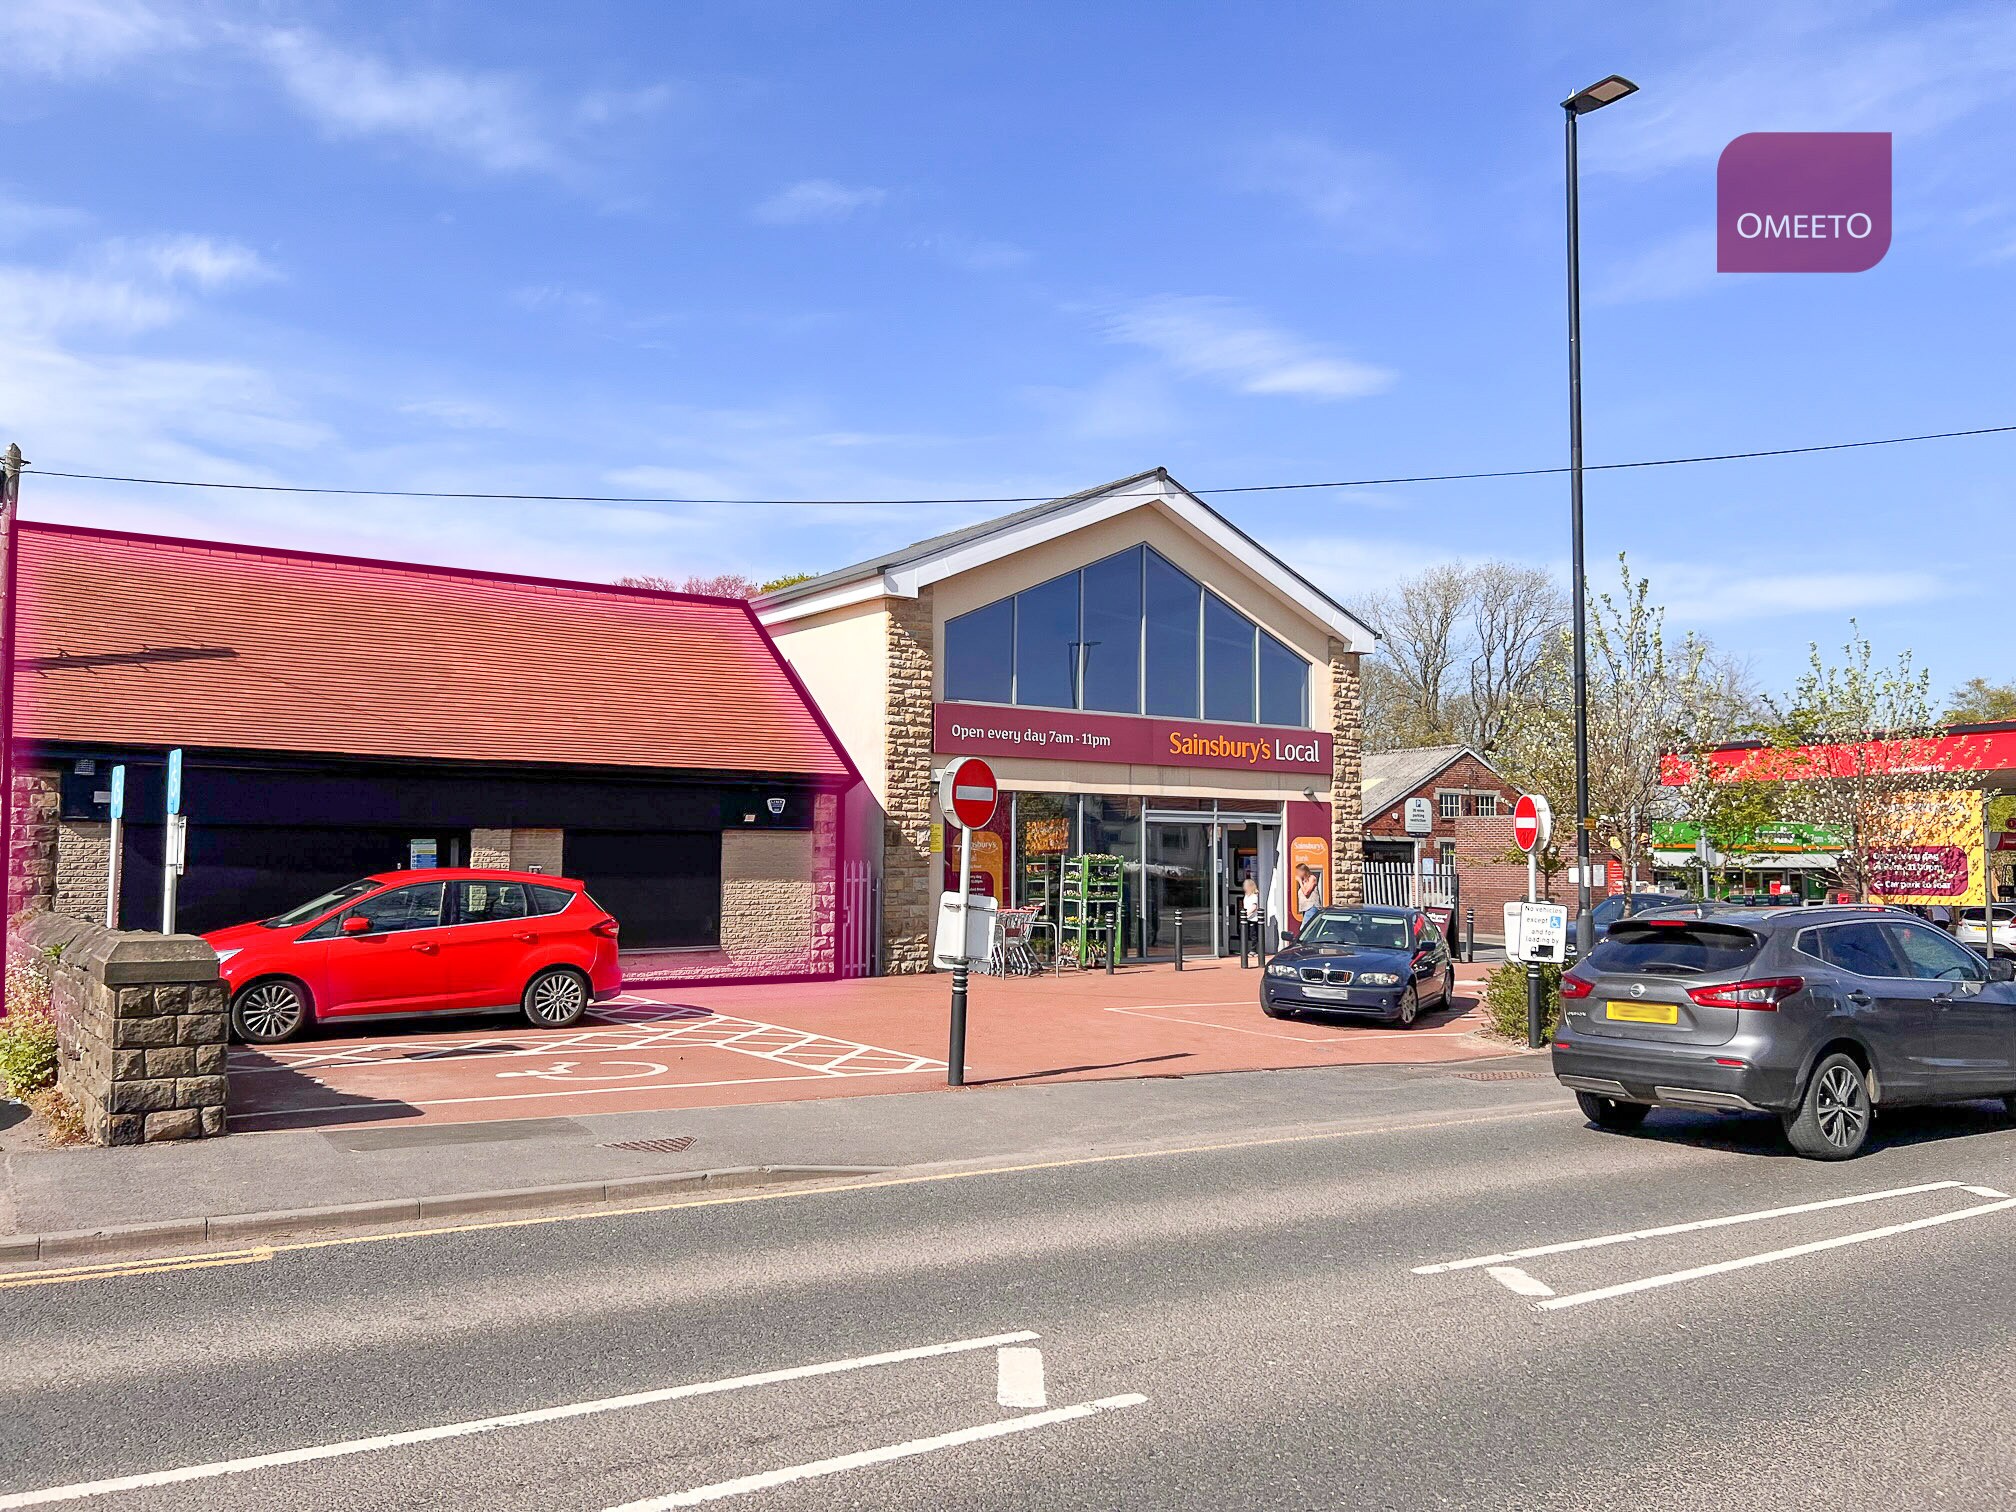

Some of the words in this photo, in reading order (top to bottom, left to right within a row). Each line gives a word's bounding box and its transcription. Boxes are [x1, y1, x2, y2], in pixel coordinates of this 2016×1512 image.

[951, 724, 984, 740] Open
[987, 728, 1021, 744] every
[1023, 729, 1046, 746] day
[1049, 731, 1074, 744] 7am
[1081, 733, 1111, 748] 11pm
[1169, 731, 1271, 763] Sainsbury's
[1275, 738, 1320, 763] Local
[1884, 880, 1899, 889] Car
[1900, 880, 1921, 890] park
[1922, 881, 1932, 889] to
[1525, 936, 1550, 944] loading
